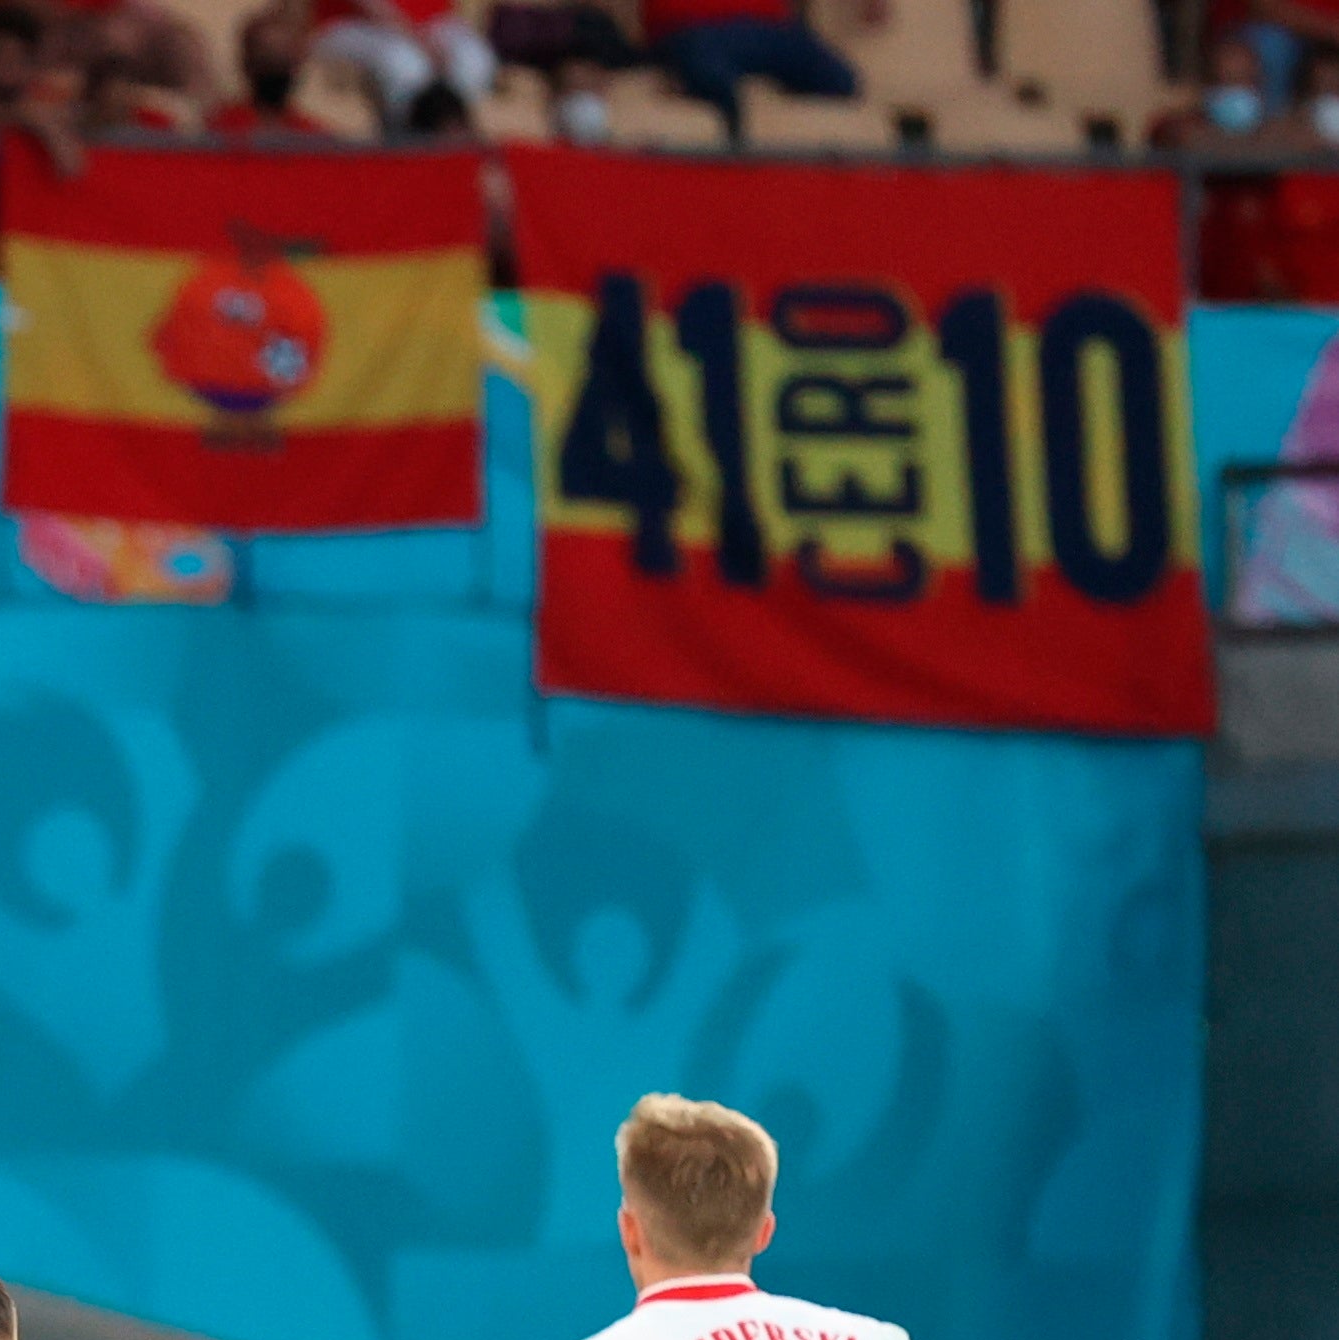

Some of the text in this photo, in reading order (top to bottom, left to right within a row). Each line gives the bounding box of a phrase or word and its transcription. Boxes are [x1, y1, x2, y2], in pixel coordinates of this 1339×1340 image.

[560, 270, 1174, 607] 41 CERO 10
